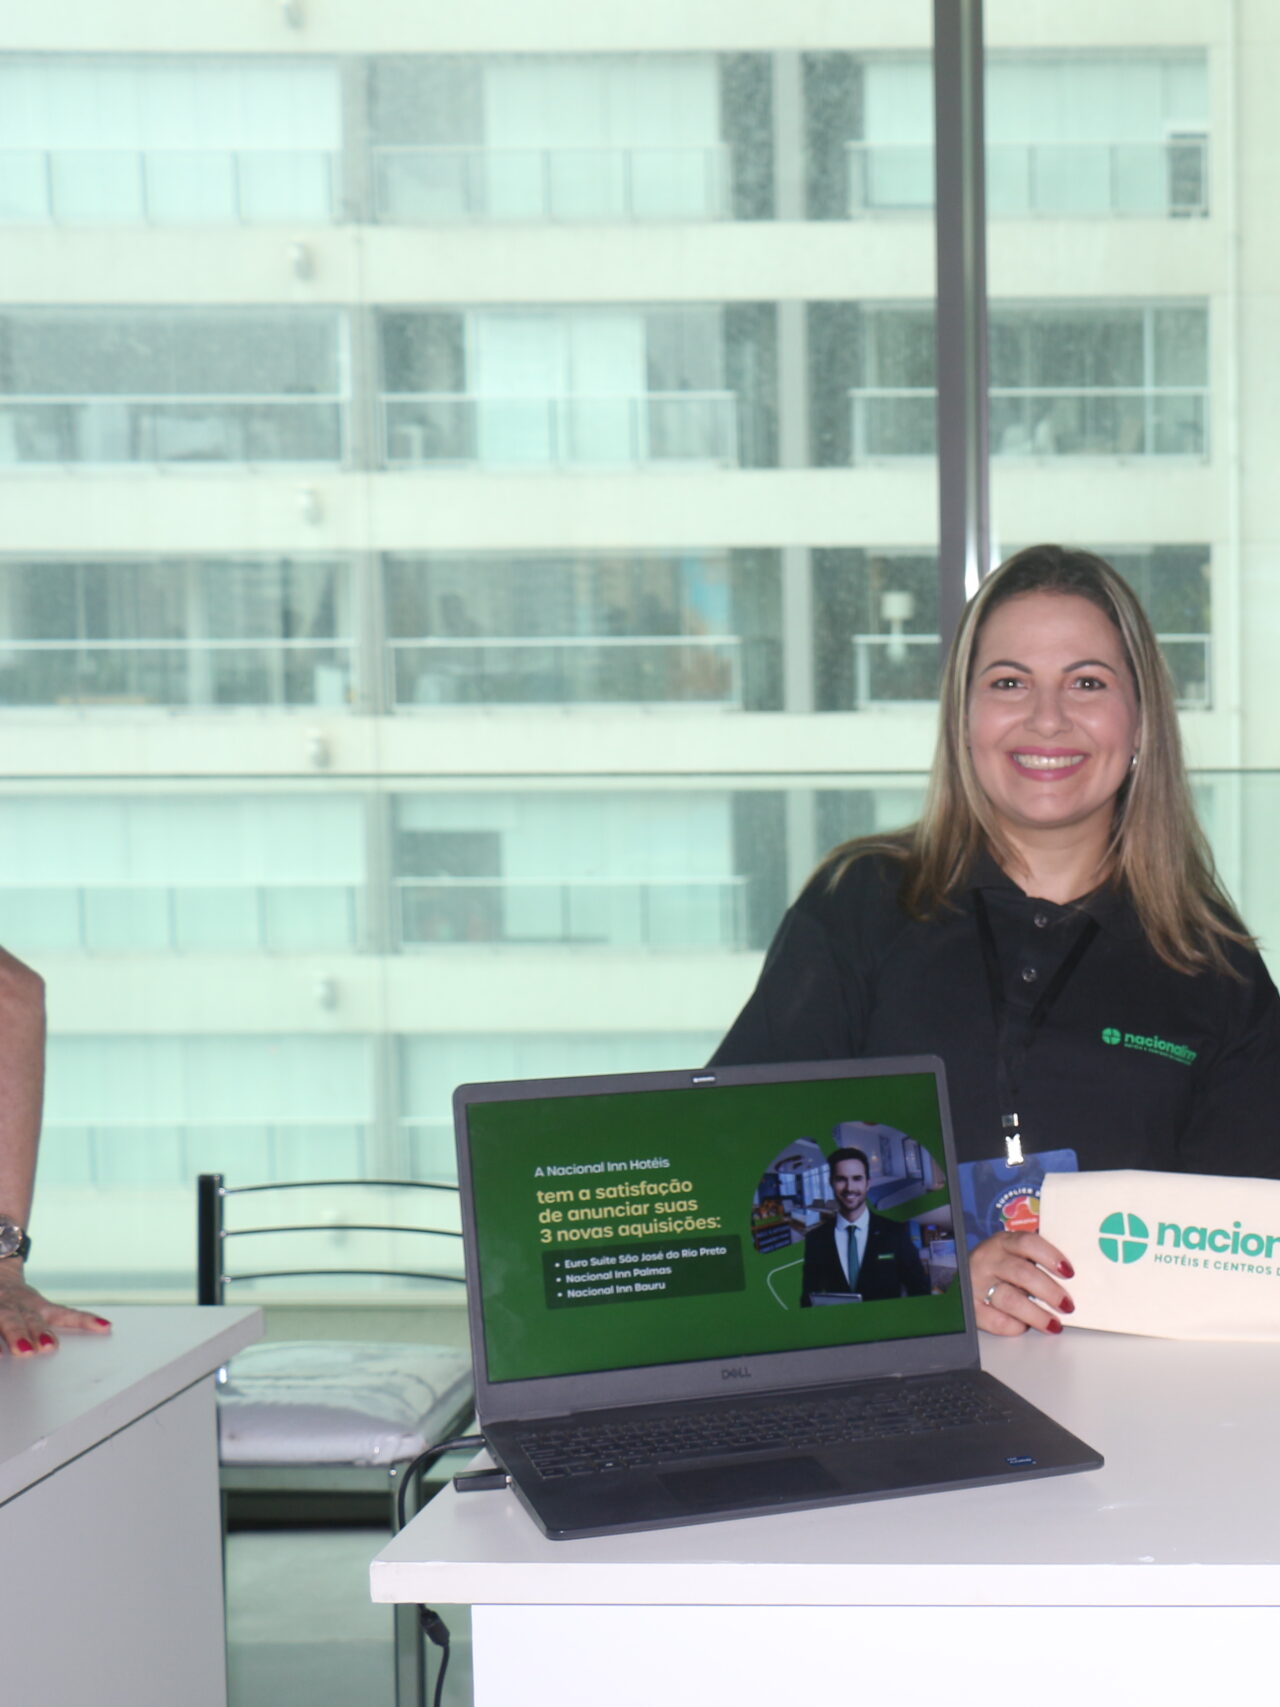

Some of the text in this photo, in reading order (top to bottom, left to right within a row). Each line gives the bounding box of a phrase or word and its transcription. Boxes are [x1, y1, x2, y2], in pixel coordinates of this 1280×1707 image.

[534, 1157, 671, 1177] A Nacional Inn Hotéis
[536, 1178, 693, 1204] tem a satisfação
[538, 1199, 698, 1224] de anunciar suas
[540, 1216, 722, 1243] 3 novas aquisições:
[564, 1246, 727, 1269] Euro Suite São José do Rio Preto
[1154, 1253, 1199, 1267] HOTÉIS
[1203, 1259, 1210, 1269] E
[1213, 1260, 1272, 1275] CENTROS
[566, 1266, 672, 1283] Nacional Inn Palmas
[567, 1282, 666, 1298] Nacional Inn Bauru
[721, 1367, 752, 1380] DELL
